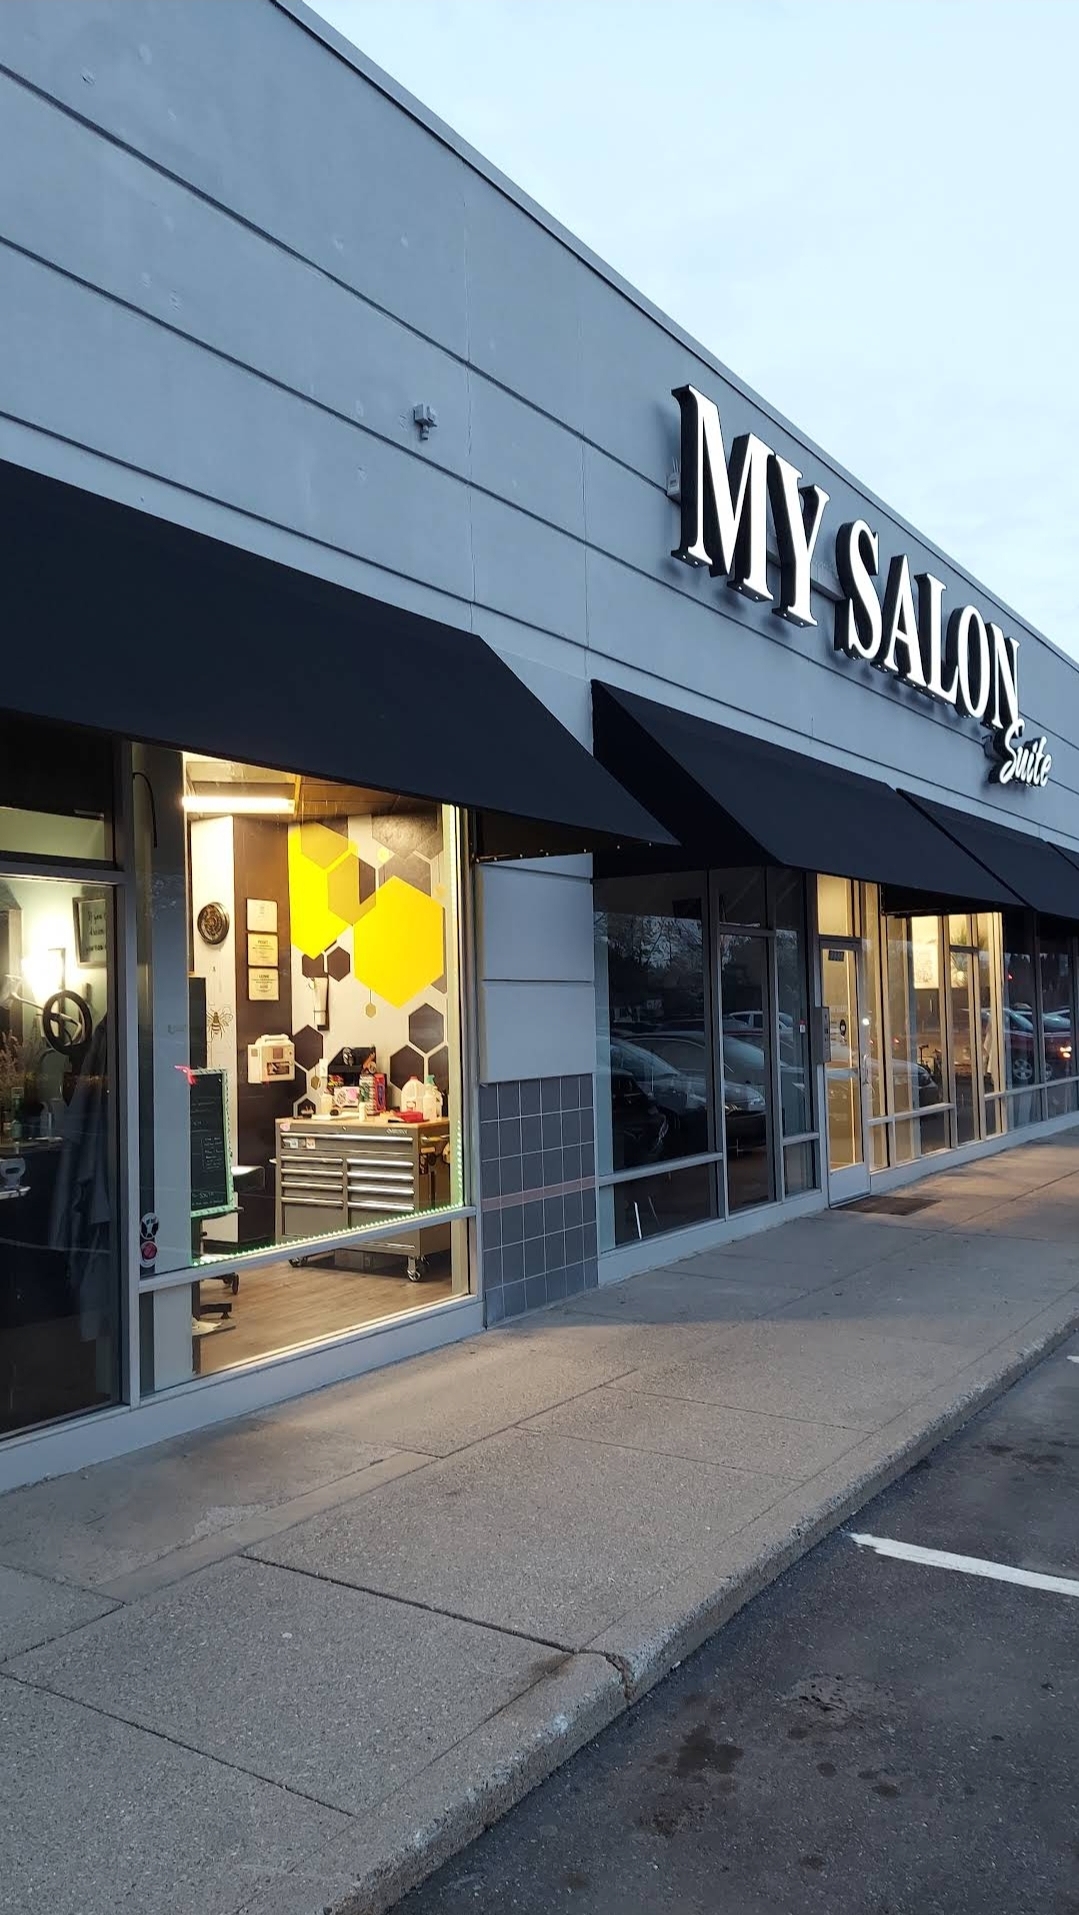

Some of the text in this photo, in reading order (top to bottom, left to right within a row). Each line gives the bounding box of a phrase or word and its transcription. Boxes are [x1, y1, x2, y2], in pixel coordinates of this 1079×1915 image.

[672, 384, 1020, 729] MY SALON
[1000, 718, 1052, 787] Suite
